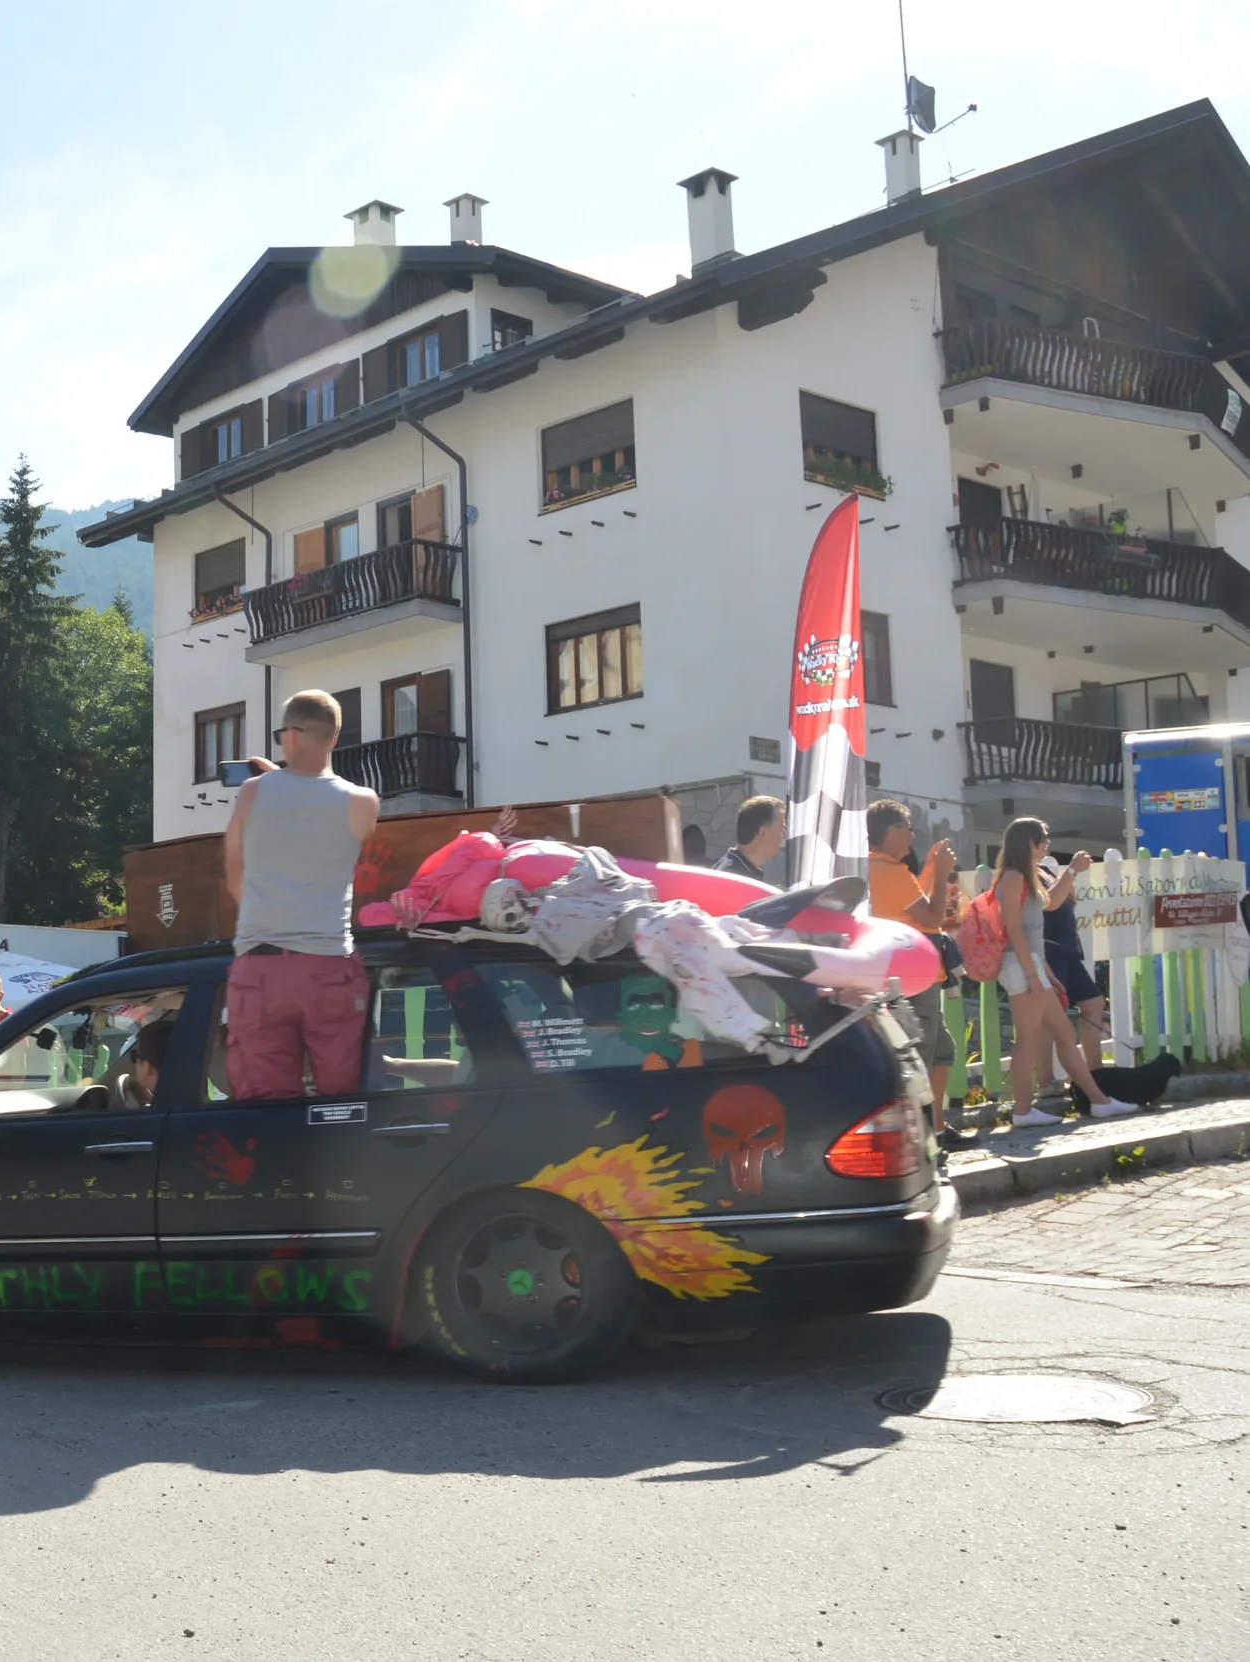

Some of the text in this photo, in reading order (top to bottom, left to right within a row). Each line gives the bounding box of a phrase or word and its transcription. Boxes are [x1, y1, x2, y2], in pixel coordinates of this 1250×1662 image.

[1076, 884, 1116, 901] con
[1076, 907, 1141, 930] a tutti!
[532, 1018, 584, 1028] M. Willmett
[538, 1026, 583, 1036] J. Bradley
[541, 1037, 587, 1046] J. Thomas
[546, 1048, 594, 1058] S. Bradley
[549, 1058, 576, 1068] D. Till
[134, 1260, 373, 1311] FELLOWS
